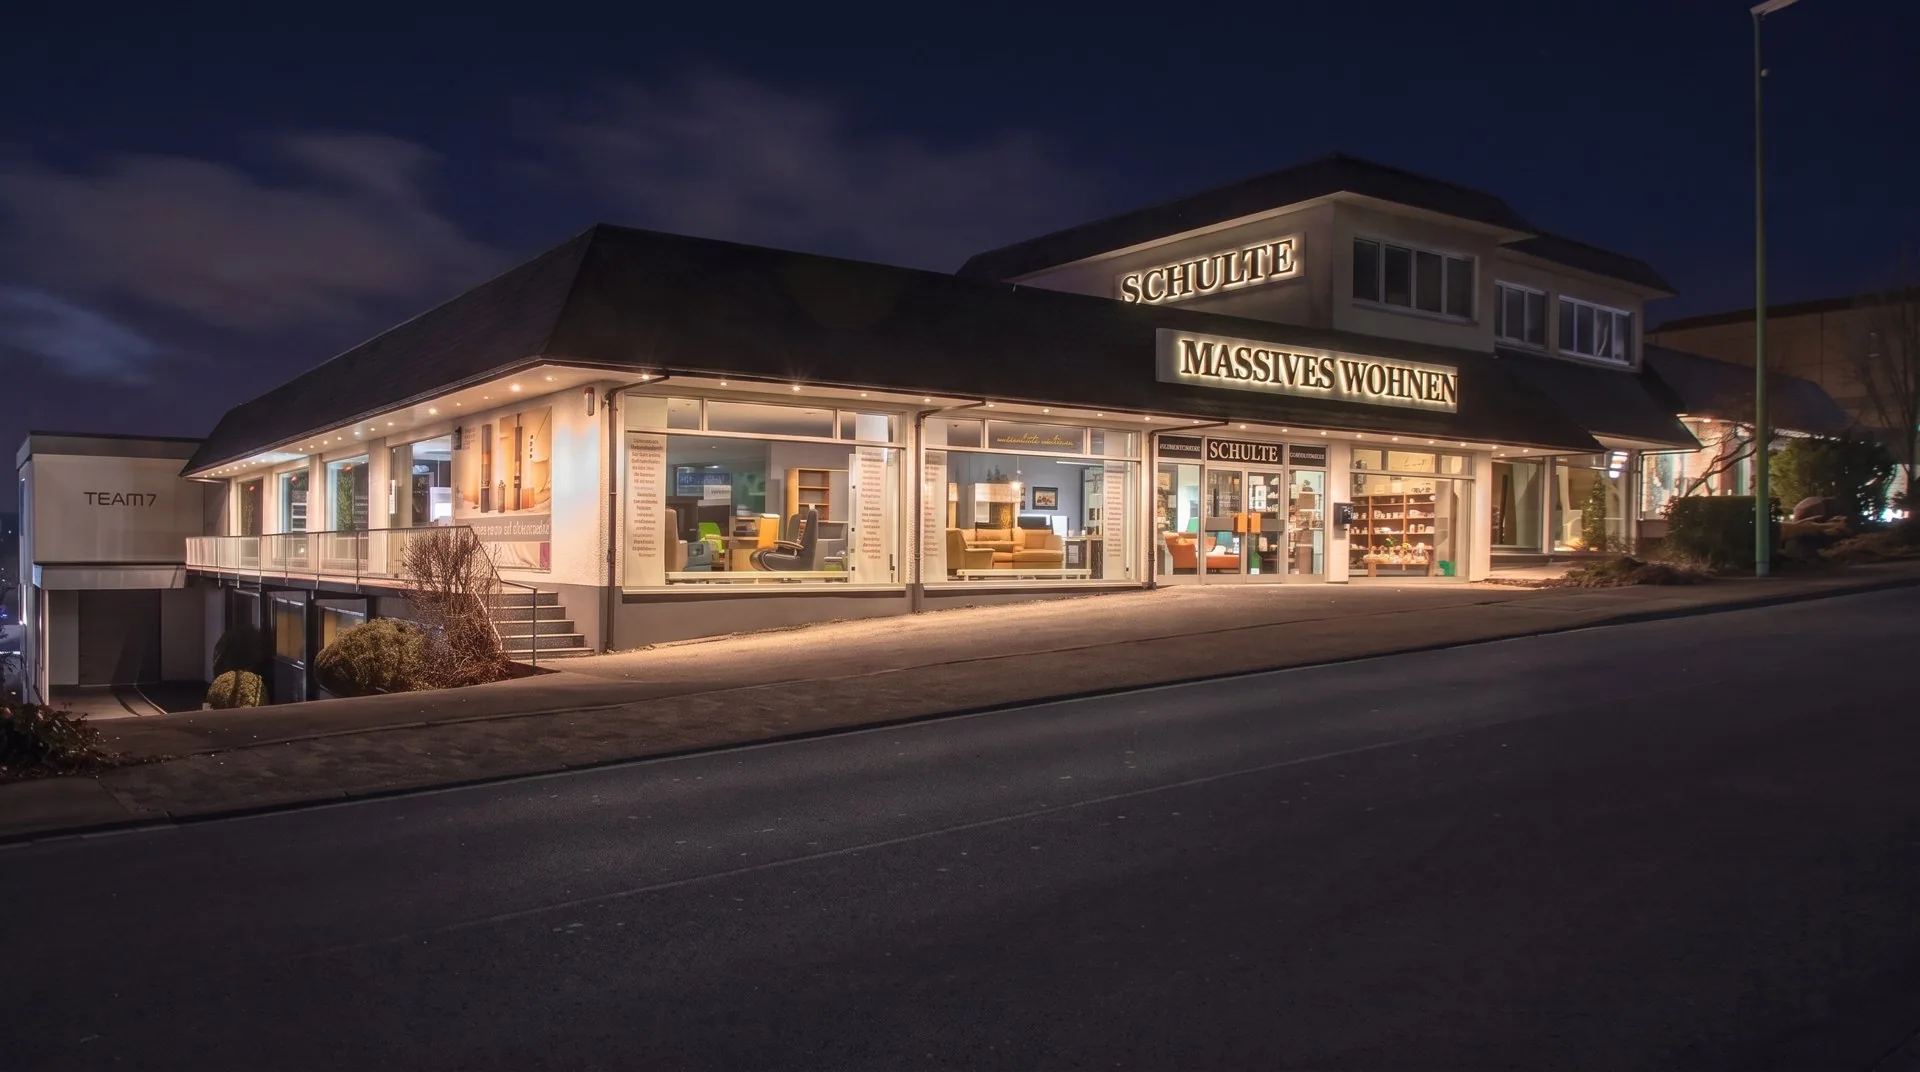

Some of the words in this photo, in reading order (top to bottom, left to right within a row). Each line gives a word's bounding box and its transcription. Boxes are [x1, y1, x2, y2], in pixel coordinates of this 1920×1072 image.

[1121, 238, 1295, 304] SCHULTE
[1180, 339, 1335, 389] MASSIVES
[1339, 359, 1458, 404] WOHNEN
[1209, 441, 1279, 462] SCHULTE
